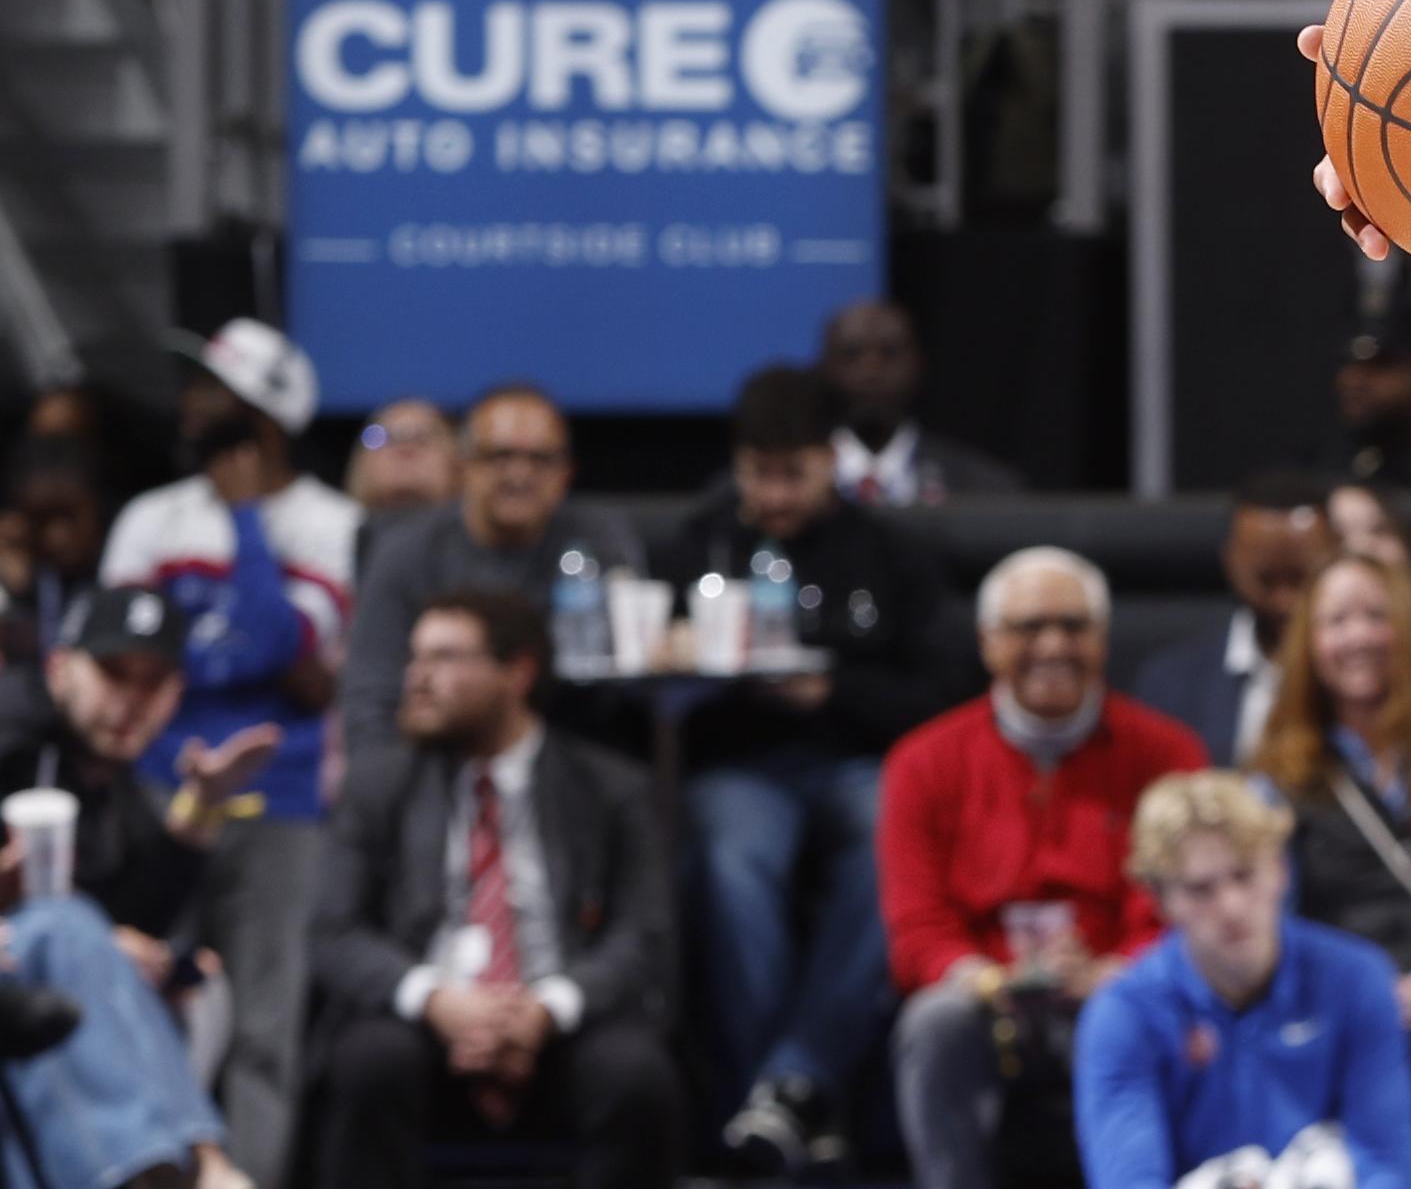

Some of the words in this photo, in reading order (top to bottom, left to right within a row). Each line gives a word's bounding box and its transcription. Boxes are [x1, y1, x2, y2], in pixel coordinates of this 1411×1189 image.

[299, 118, 475, 174] AUTO
[493, 118, 874, 175] INSURANCE
[389, 221, 649, 268] COURTSIDE
[655, 221, 783, 268] CLUB
